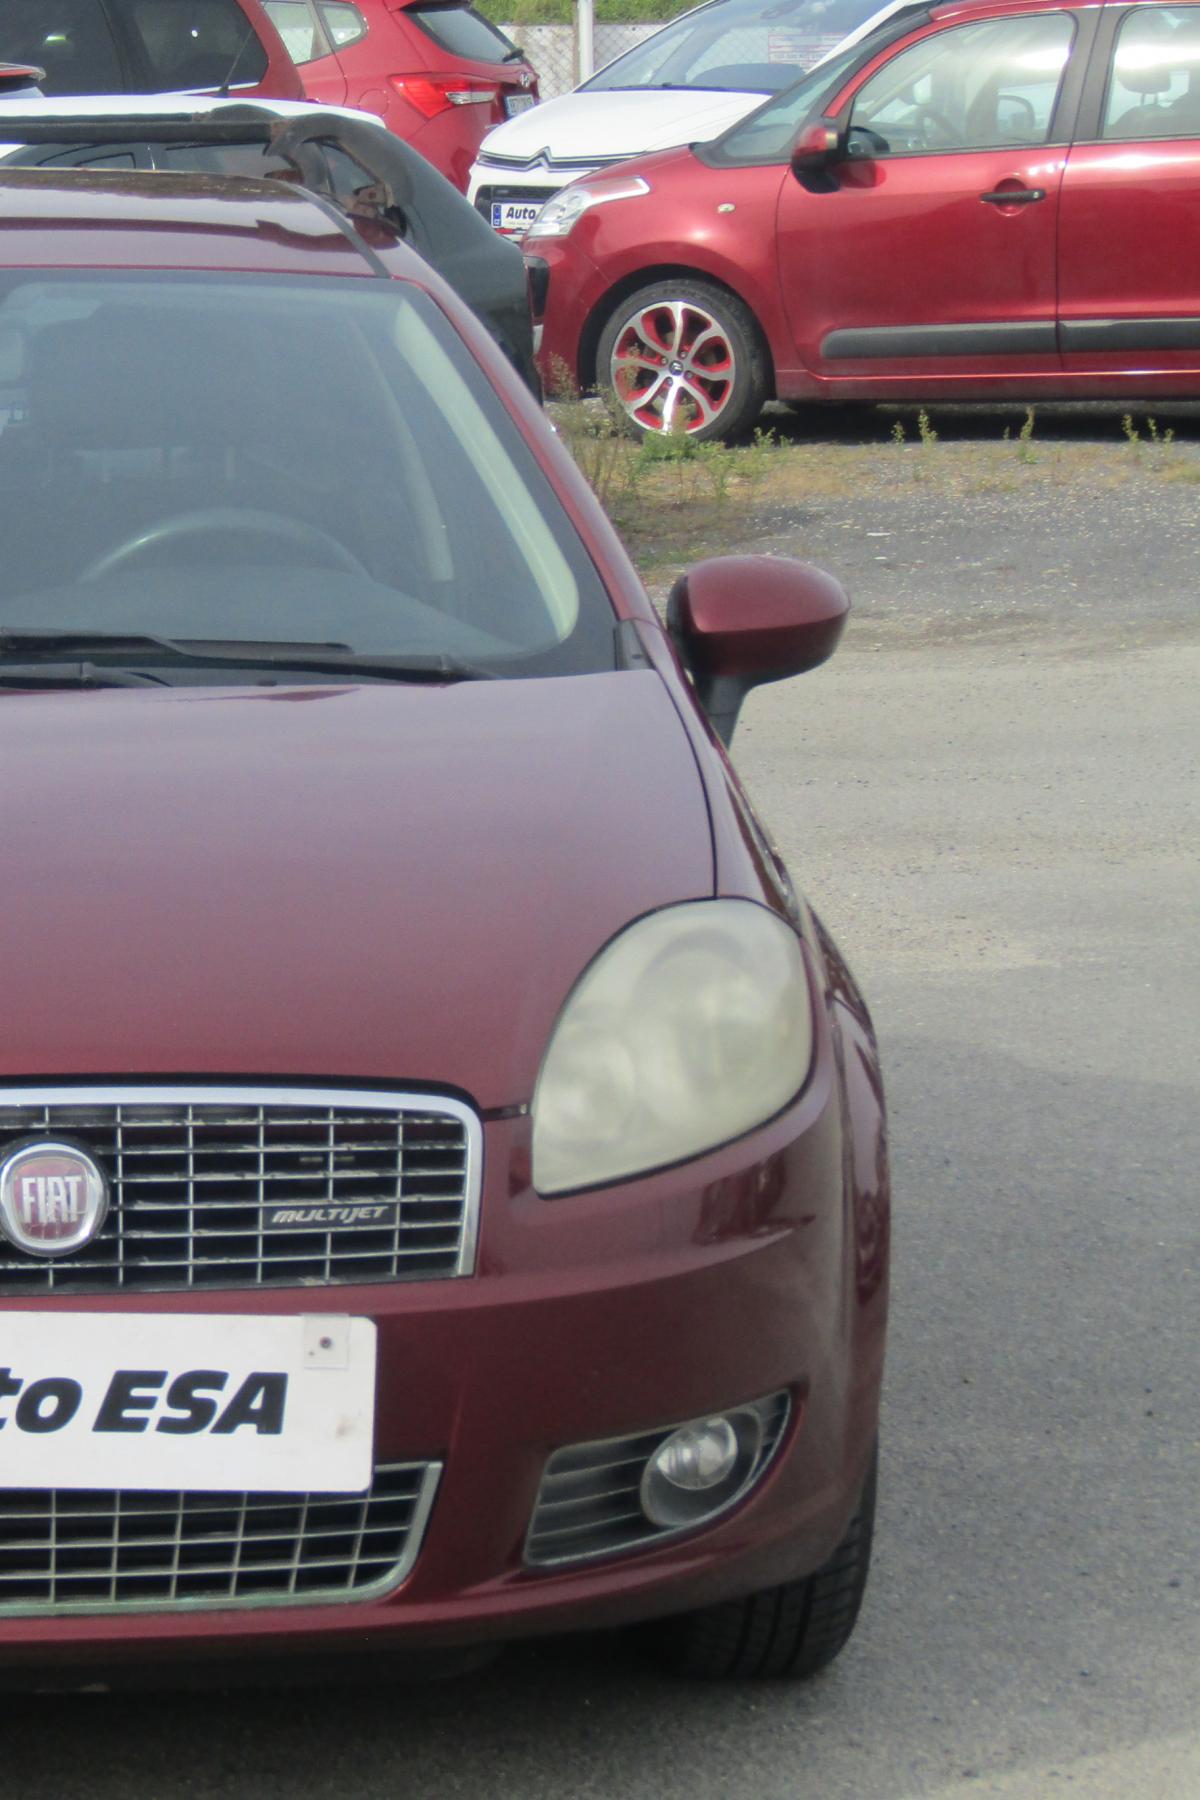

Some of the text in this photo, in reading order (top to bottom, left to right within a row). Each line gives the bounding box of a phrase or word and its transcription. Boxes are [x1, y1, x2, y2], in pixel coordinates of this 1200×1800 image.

[505, 206, 536, 219] Auto
[21, 1174, 82, 1223] FIAT
[271, 1205, 388, 1224] MULTIJET
[92, 1370, 289, 1435] ESA
